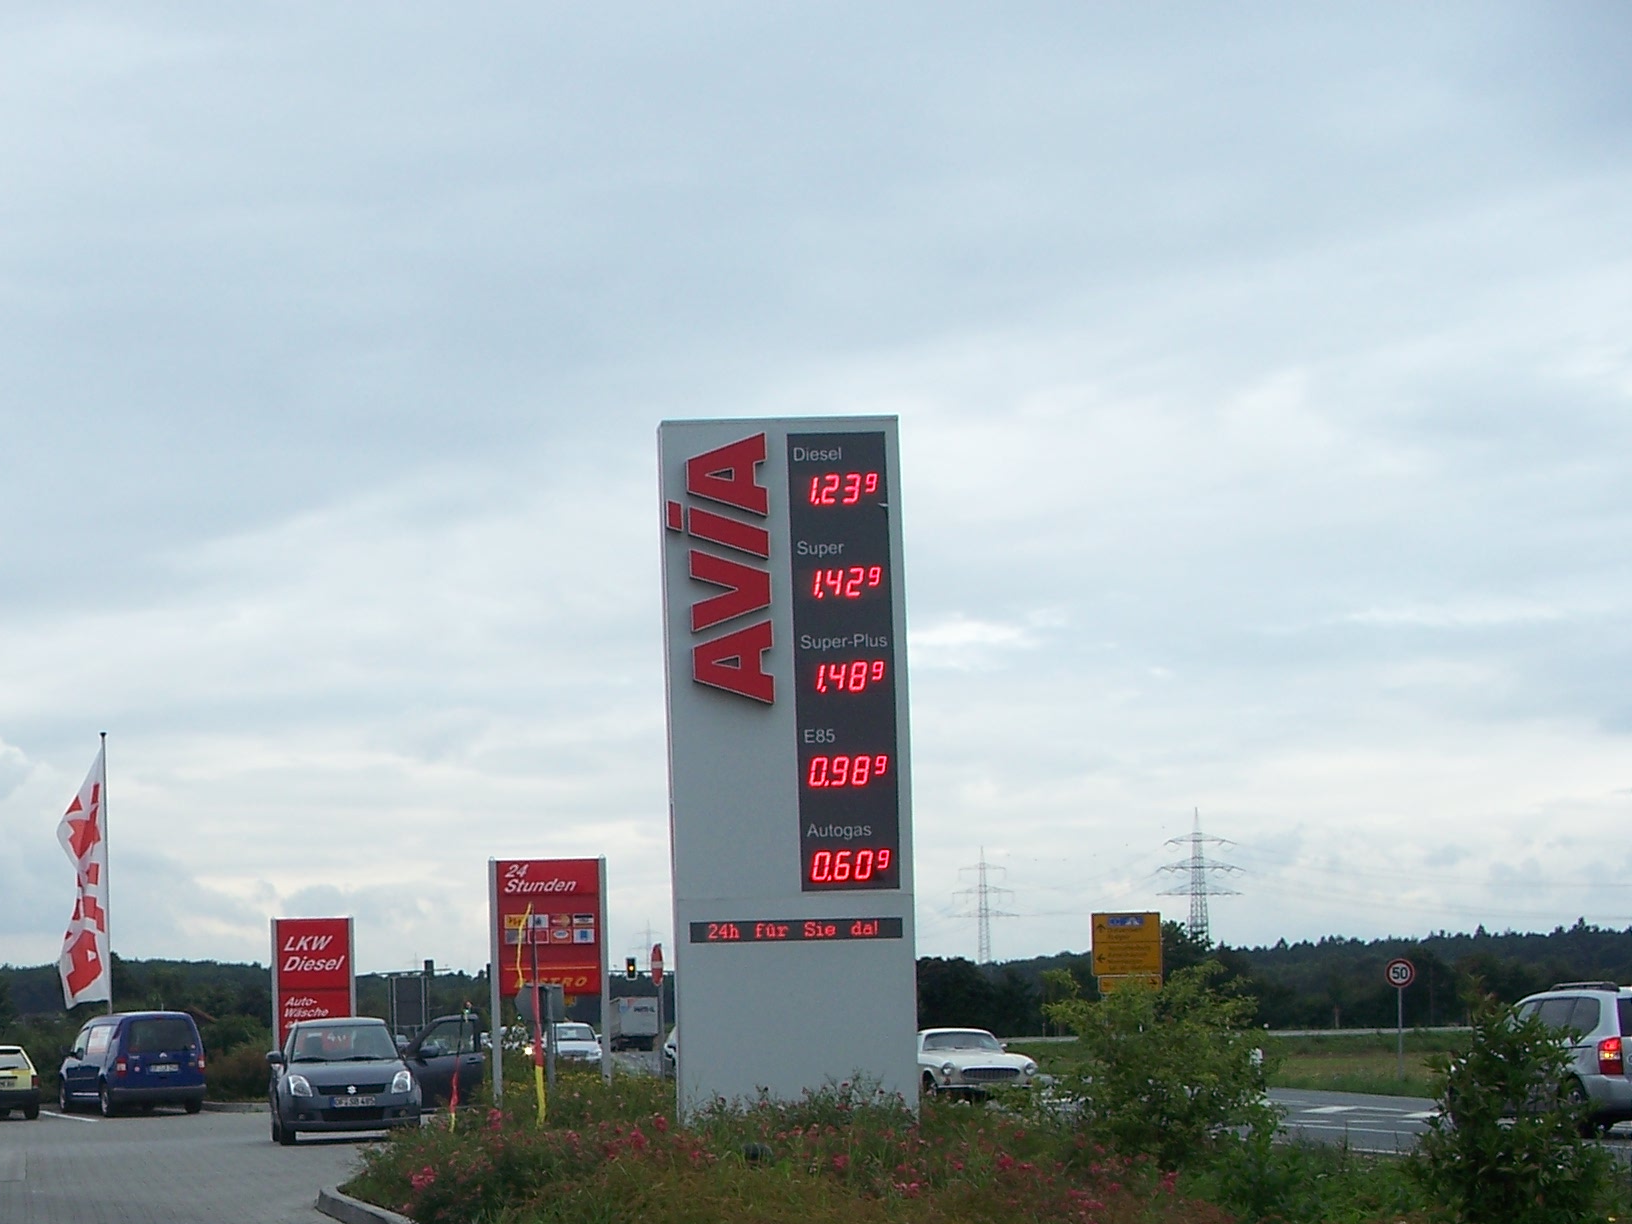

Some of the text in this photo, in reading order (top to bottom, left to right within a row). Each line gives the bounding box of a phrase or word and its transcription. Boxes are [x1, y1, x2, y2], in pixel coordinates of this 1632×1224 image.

[793, 446, 843, 462] Diesel
[796, 540, 845, 557] Super
[799, 633, 889, 651] Super-Plus
[803, 728, 836, 744] E85
[806, 823, 873, 841] Autogas
[504, 863, 529, 878] 24
[504, 878, 577, 893] Stunden
[707, 923, 740, 940] 24h
[754, 922, 789, 939] für
[803, 921, 836, 937] Sie
[283, 934, 333, 952] LKW
[282, 954, 346, 972] Diesel
[1392, 966, 1409, 980] 50
[284, 996, 318, 1007] Auto-
[283, 1006, 329, 1018] Wäsche
